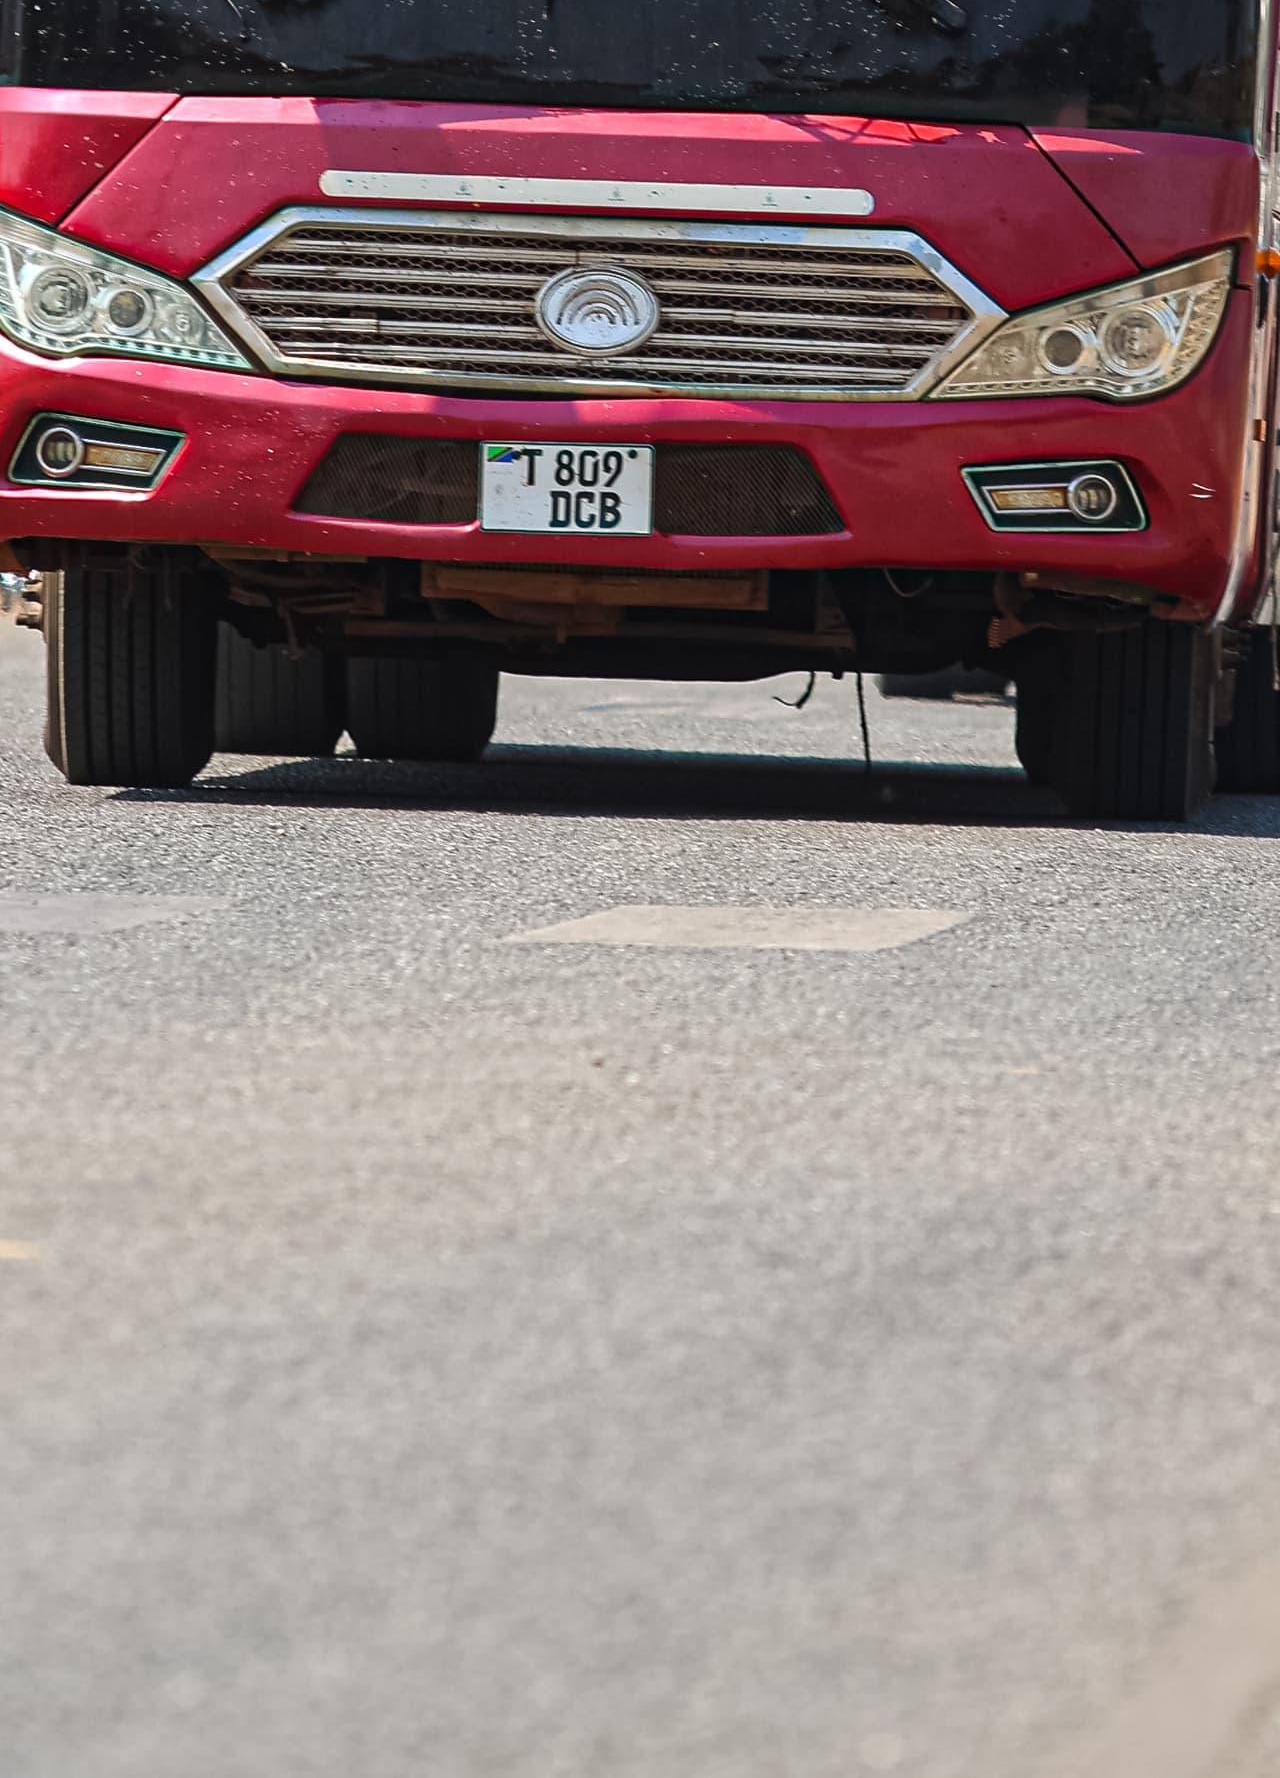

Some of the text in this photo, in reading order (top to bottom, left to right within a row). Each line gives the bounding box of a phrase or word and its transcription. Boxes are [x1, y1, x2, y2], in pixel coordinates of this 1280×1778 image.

[521, 448, 623, 488] T 809
[549, 490, 622, 529] DCB
